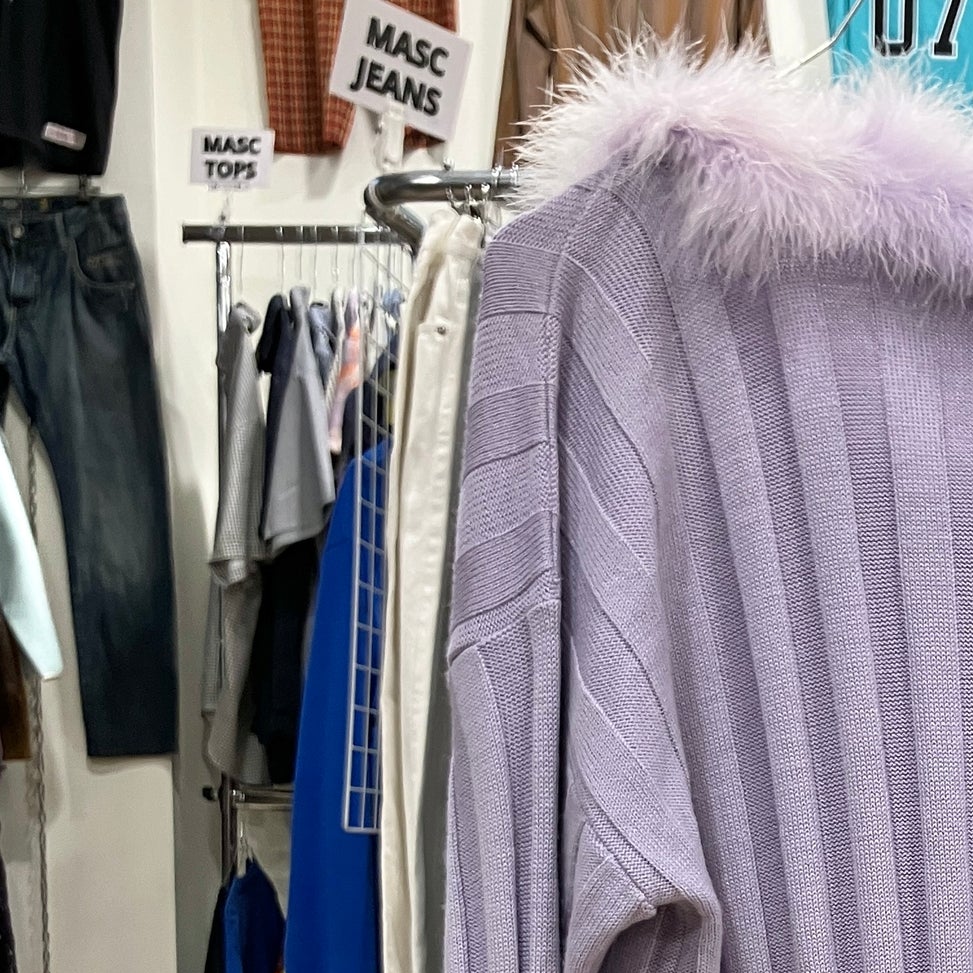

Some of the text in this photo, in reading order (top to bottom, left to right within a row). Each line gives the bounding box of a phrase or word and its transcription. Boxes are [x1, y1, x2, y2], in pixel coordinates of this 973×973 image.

[366, 15, 449, 78] MASC
[349, 56, 442, 117] JEANS
[203, 135, 262, 155] MASC
[204, 159, 258, 180] TOPS
